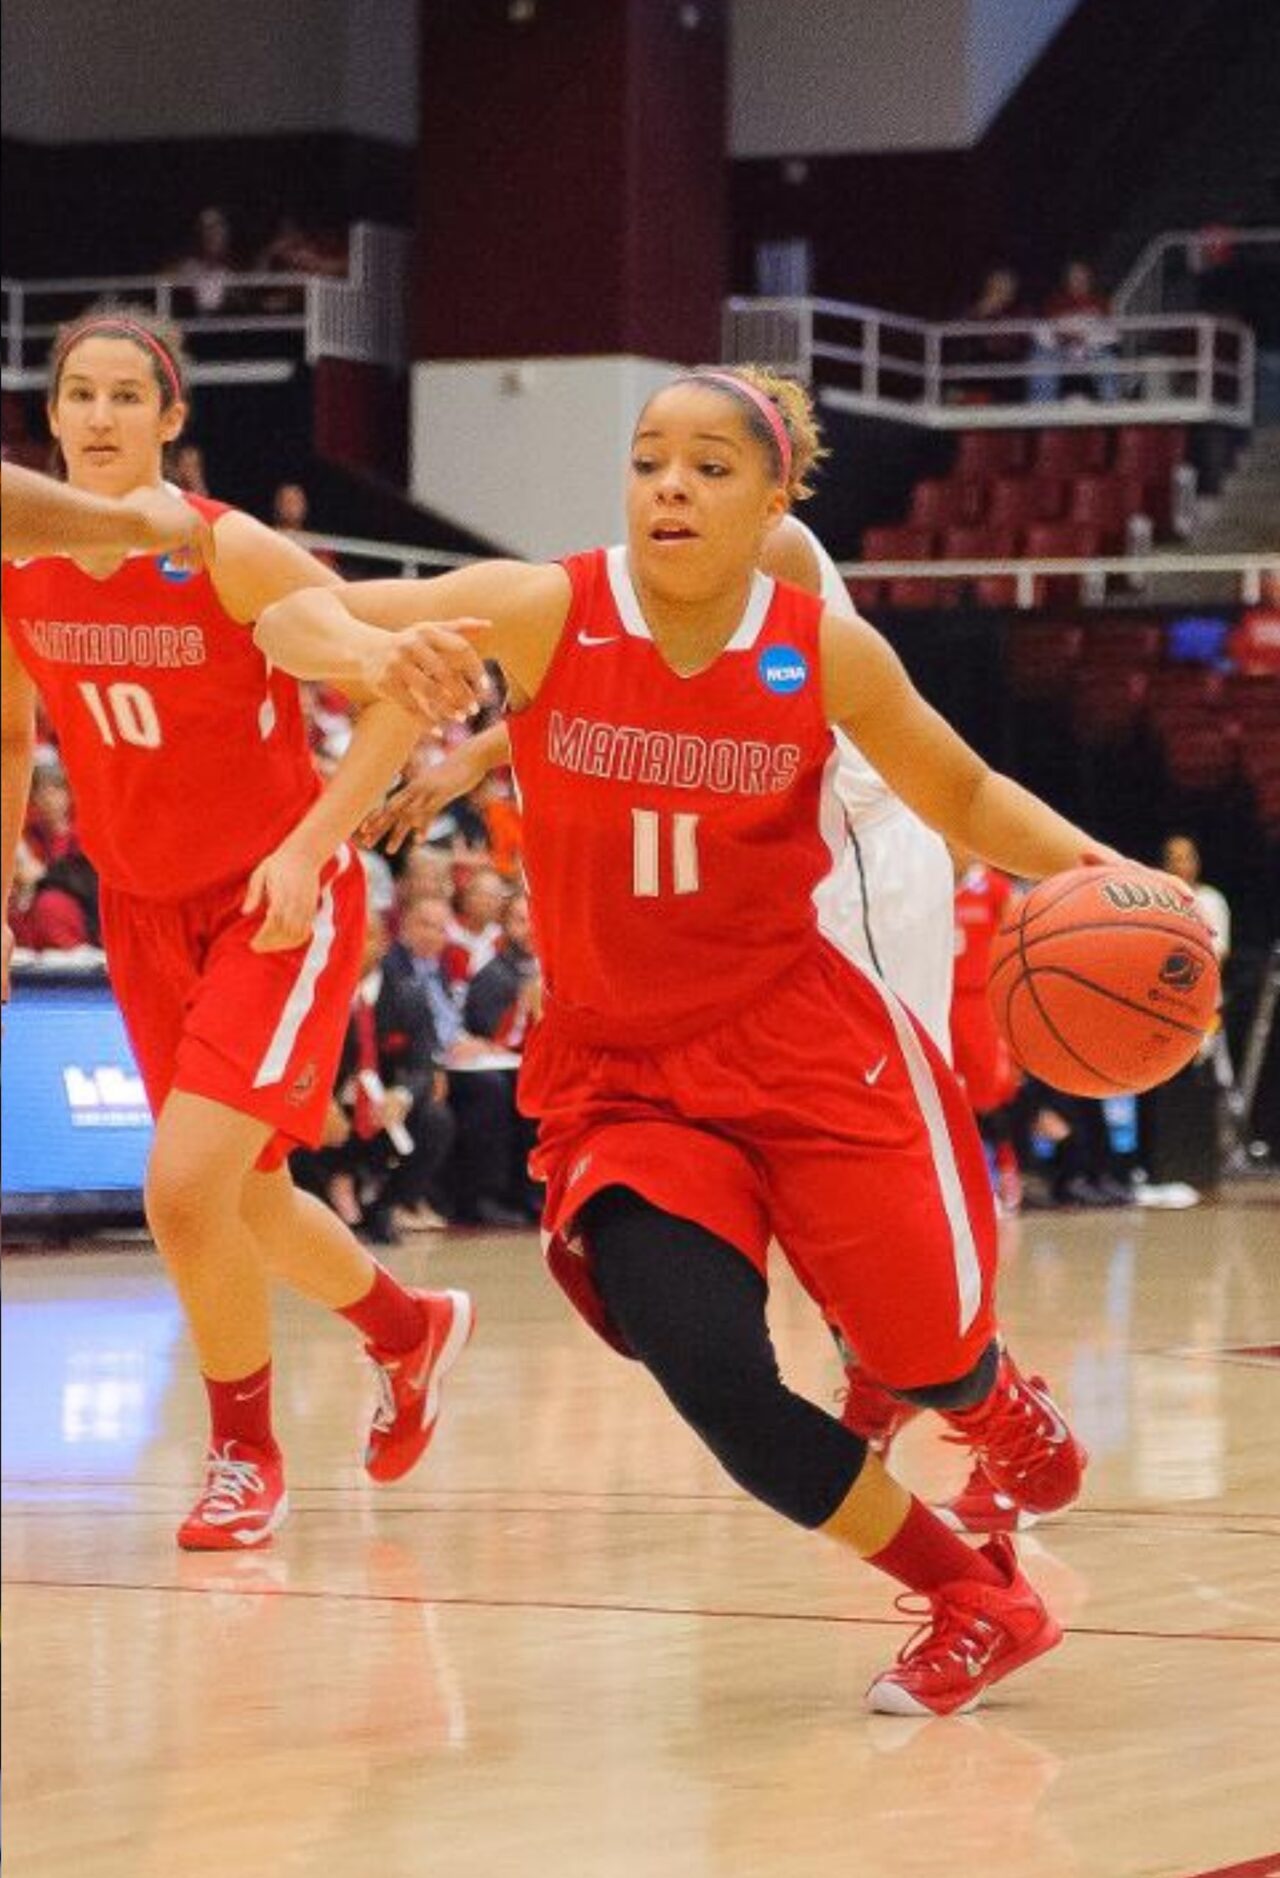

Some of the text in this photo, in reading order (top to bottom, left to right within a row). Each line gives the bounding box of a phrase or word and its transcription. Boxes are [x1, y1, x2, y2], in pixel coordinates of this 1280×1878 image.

[20, 619, 206, 668] MATADORS
[767, 666, 805, 682] NCAA
[77, 681, 163, 749] 10
[548, 711, 800, 795] MATADORS
[631, 808, 700, 897] 11
